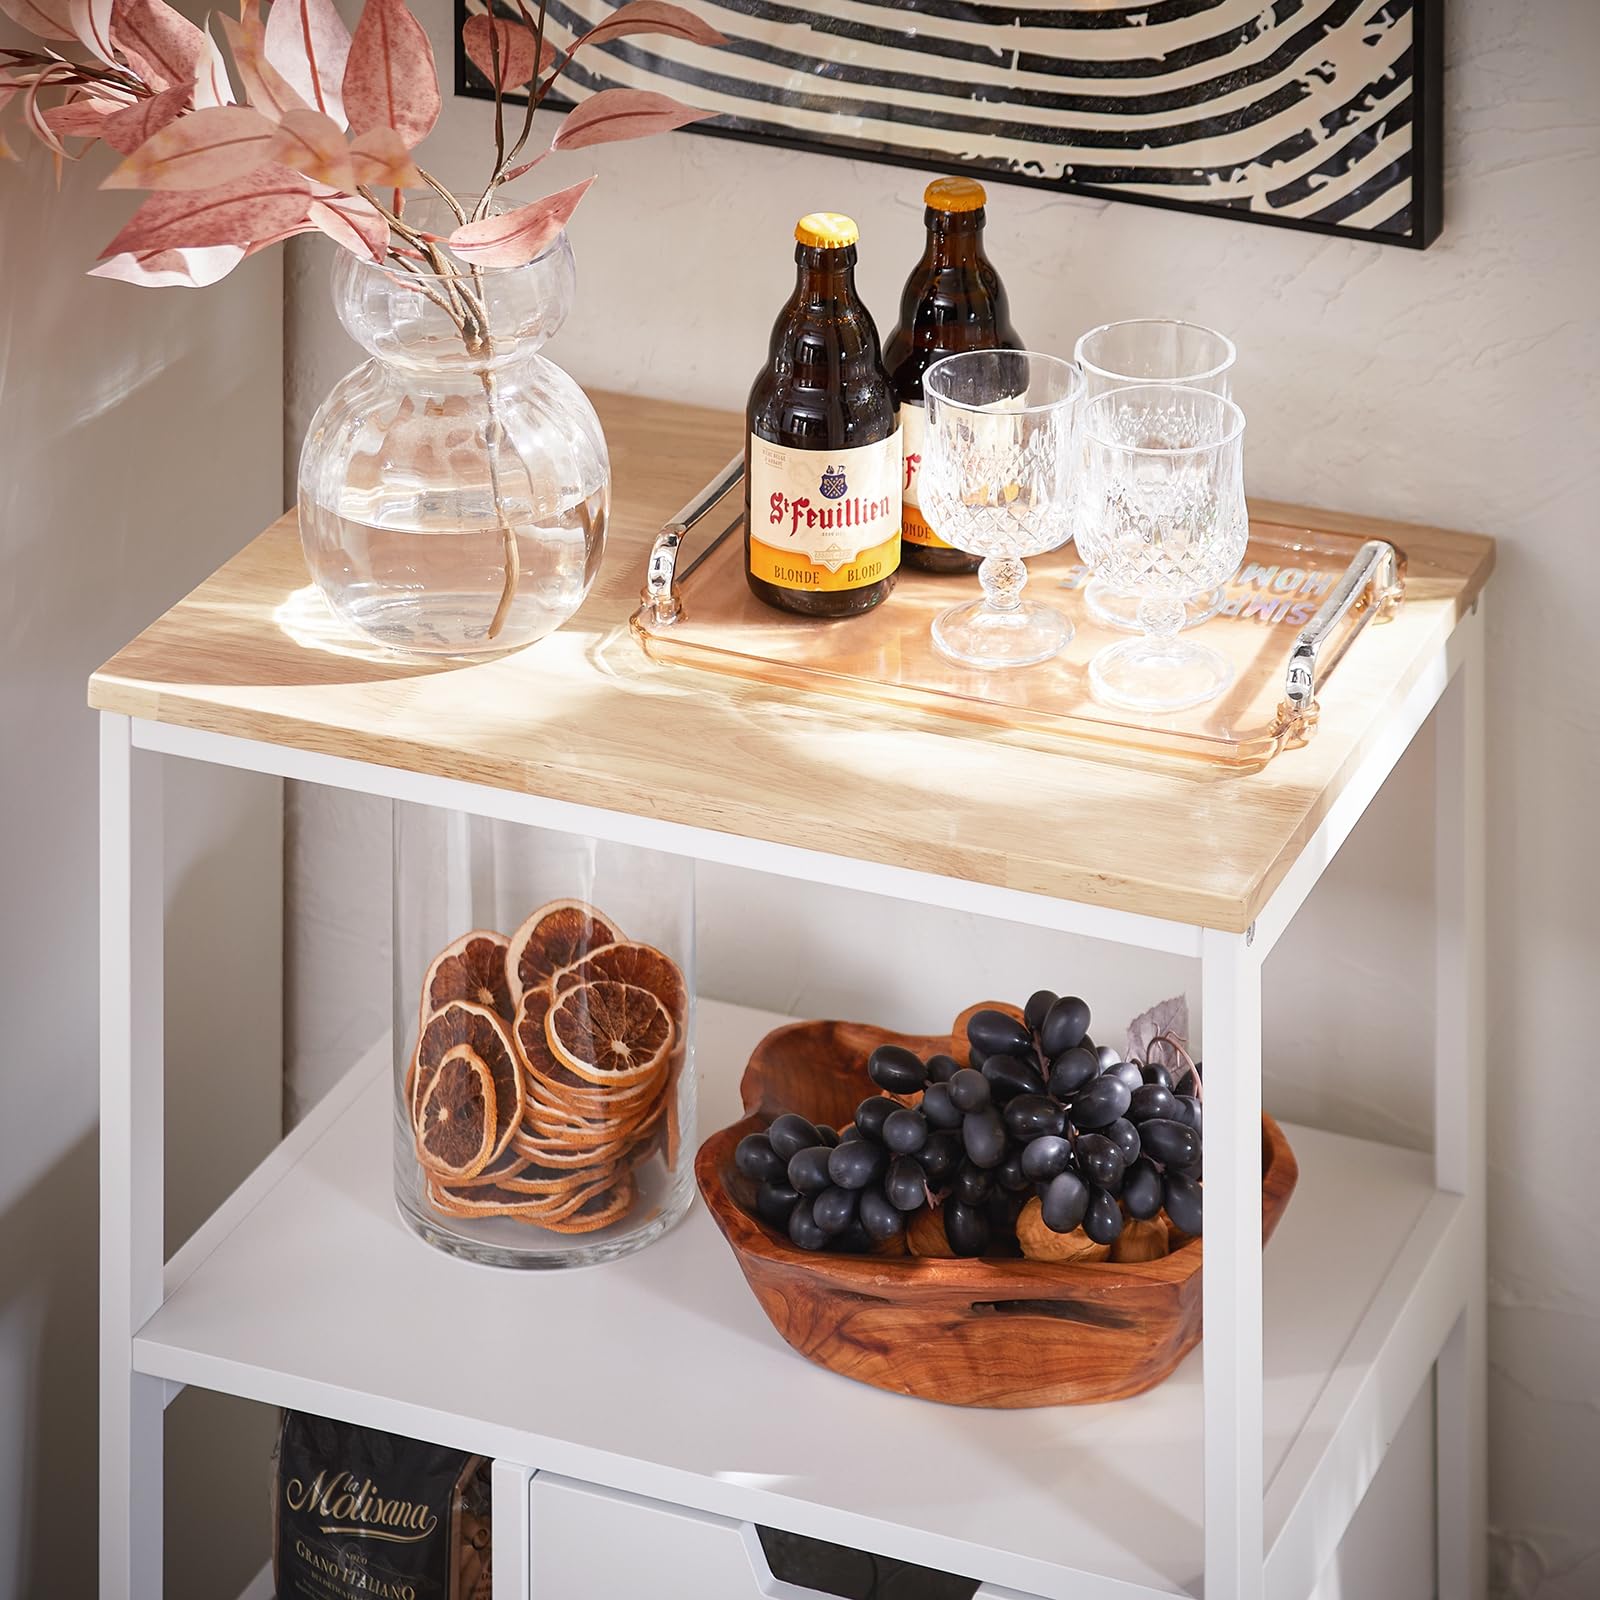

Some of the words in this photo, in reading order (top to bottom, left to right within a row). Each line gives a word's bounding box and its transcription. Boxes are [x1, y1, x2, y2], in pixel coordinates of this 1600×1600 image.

[790, 495, 890, 537] Feuillien
[774, 565, 820, 584] BLONDE
[847, 561, 882, 582] BLOND
[287, 1470, 438, 1534] Molisana
[296, 1540, 339, 1577] GRANO
[341, 1567, 416, 1600] ITALIANO
